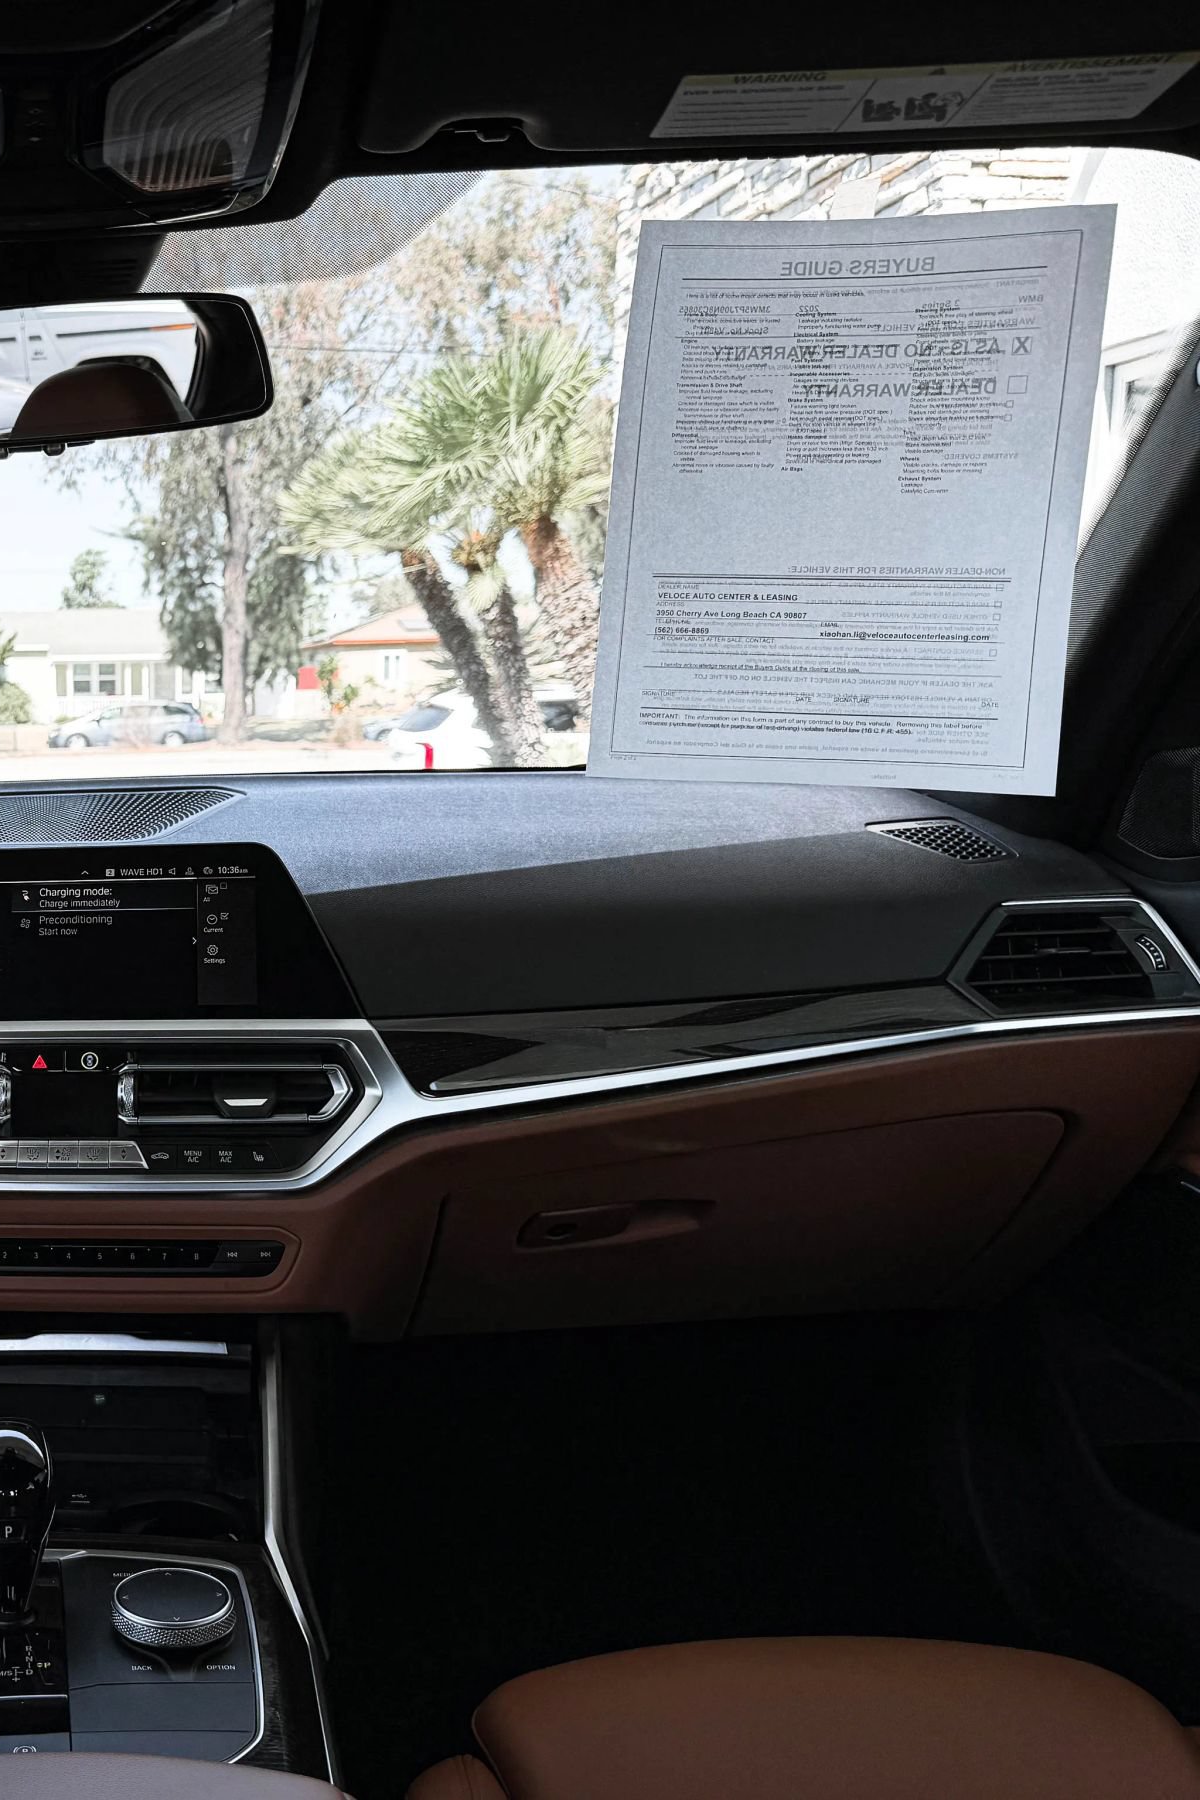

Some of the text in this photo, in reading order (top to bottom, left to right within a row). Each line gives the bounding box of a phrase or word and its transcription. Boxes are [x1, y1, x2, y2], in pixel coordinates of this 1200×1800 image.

[733, 72, 828, 85] WARNING
[657, 592, 691, 600] VELOCE
[692, 593, 716, 601] AUTO
[717, 593, 751, 601] CENTER
[761, 594, 798, 602] LEASING
[676, 610, 702, 619] Cherry
[720, 611, 741, 620] Long
[742, 611, 767, 619] Beach
[783, 612, 807, 620] 90807
[654, 626, 674, 635] (562)
[819, 631, 990, 643] xiaohan.li@veloceautocenterleasing.com
[752, 716, 767, 724] form
[774, 717, 788, 726] part
[795, 720, 807, 728] any
[896, 721, 930, 730] Removing
[120, 868, 164, 877] WAVE HD1
[39, 886, 113, 900] Charging mode:
[39, 898, 121, 910] Charge immediately
[39, 914, 113, 926] Preconditioning
[38, 927, 78, 936] Start now
[203, 957, 226, 965] Settings
[2, 1251, 8, 1259] 2
[33, 1252, 39, 1260] 3
[97, 1252, 103, 1260] 5
[161, 1252, 167, 1260] 7
[5, 1525, 13, 1538] P
